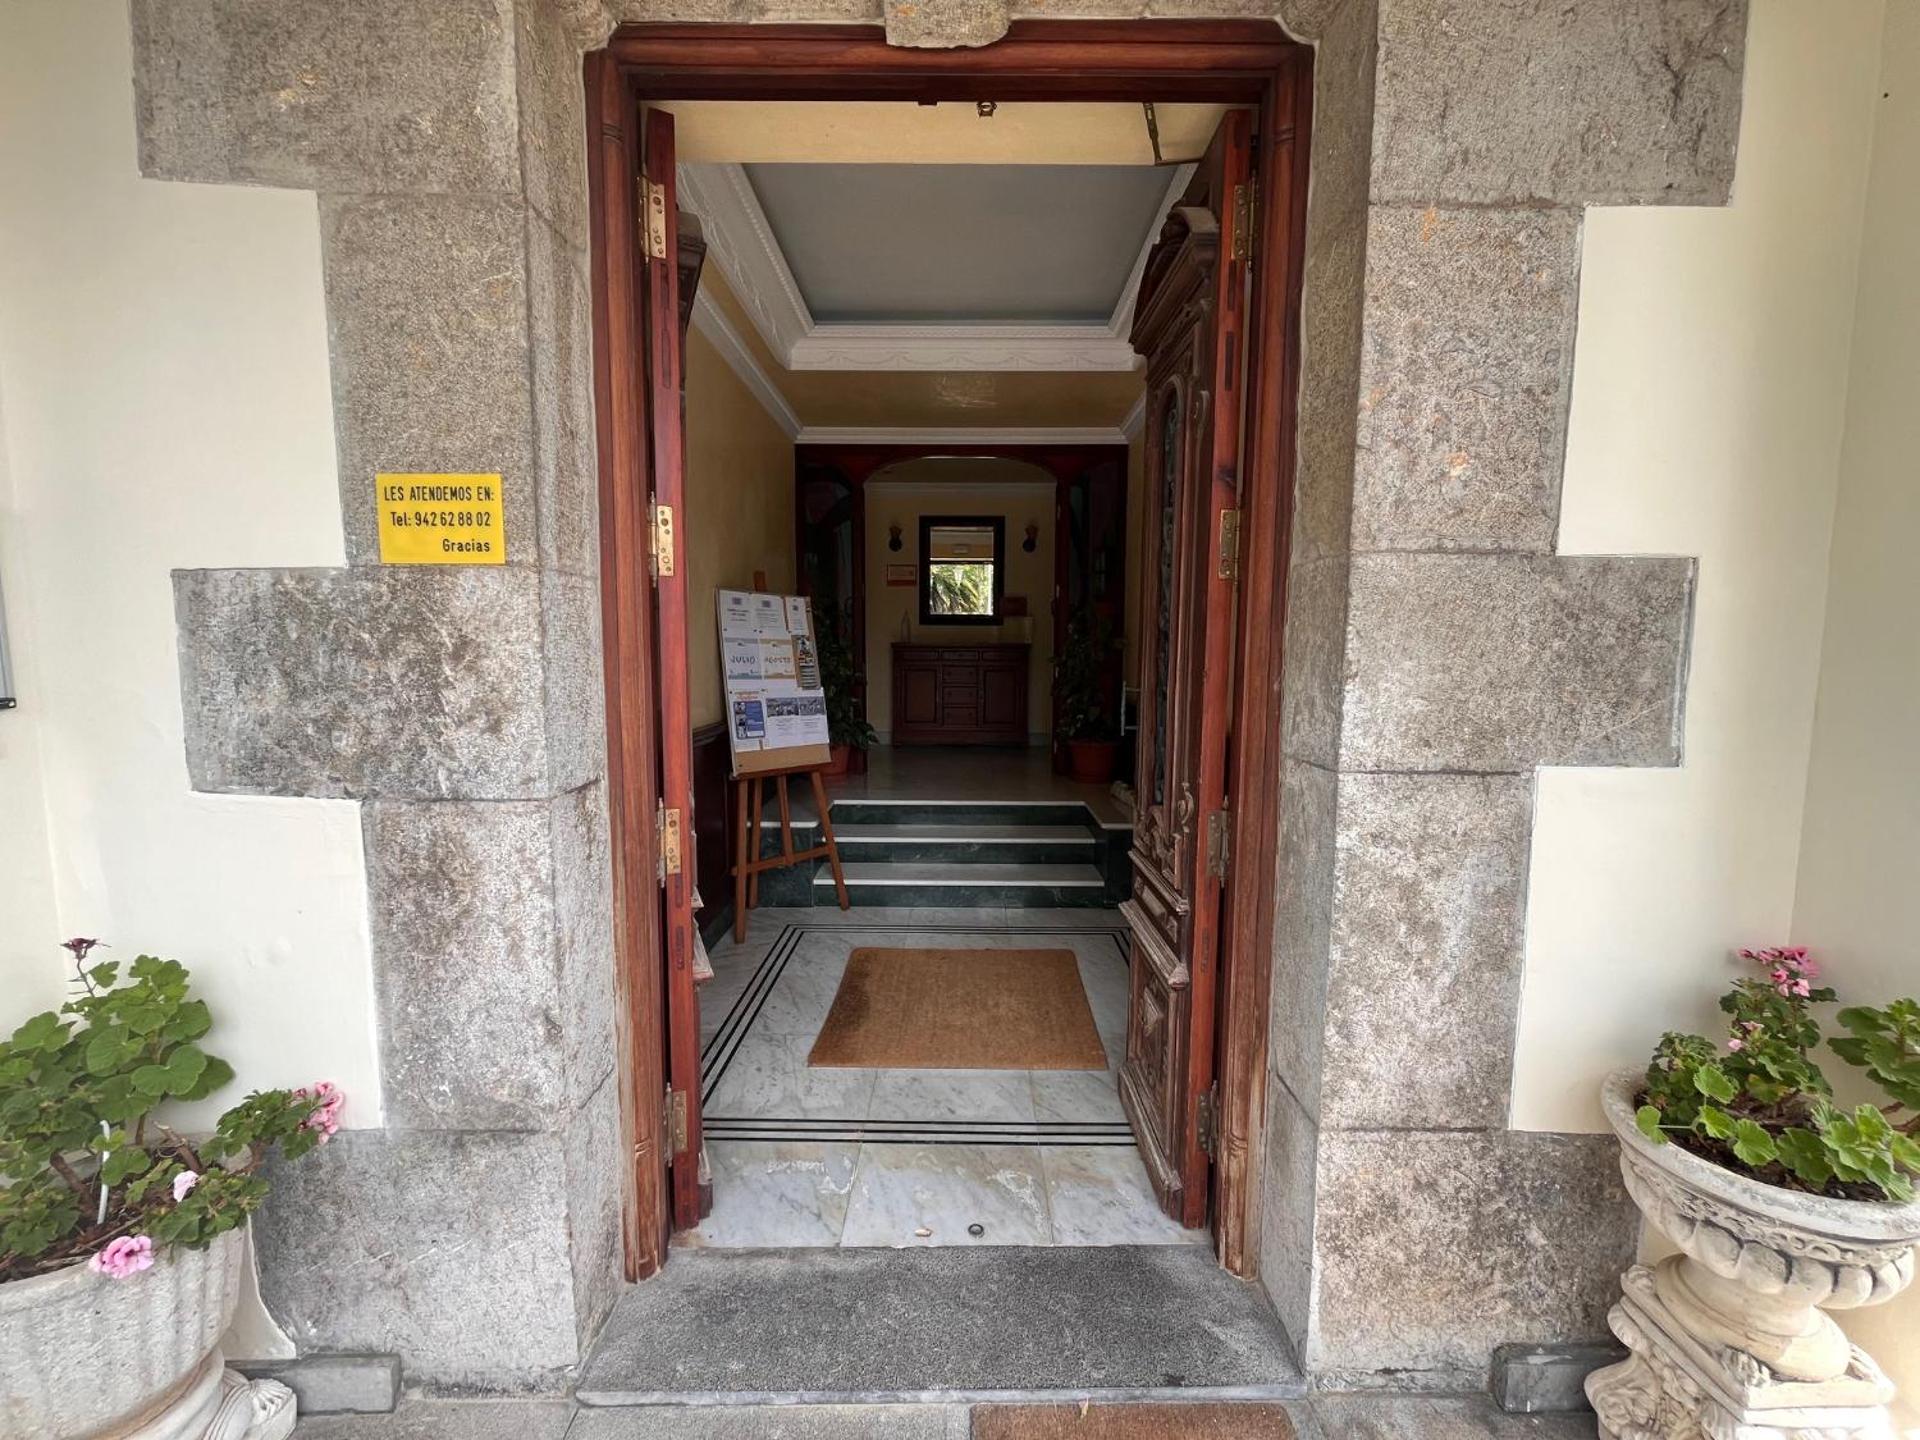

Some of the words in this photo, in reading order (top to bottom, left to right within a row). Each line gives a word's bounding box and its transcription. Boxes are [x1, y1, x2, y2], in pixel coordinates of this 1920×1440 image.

[384, 486, 404, 501] LES
[410, 486, 472, 501] ATENDEMOS
[477, 486, 495, 501] EN:
[391, 512, 411, 527] Tel:
[442, 538, 490, 553] Gracias
